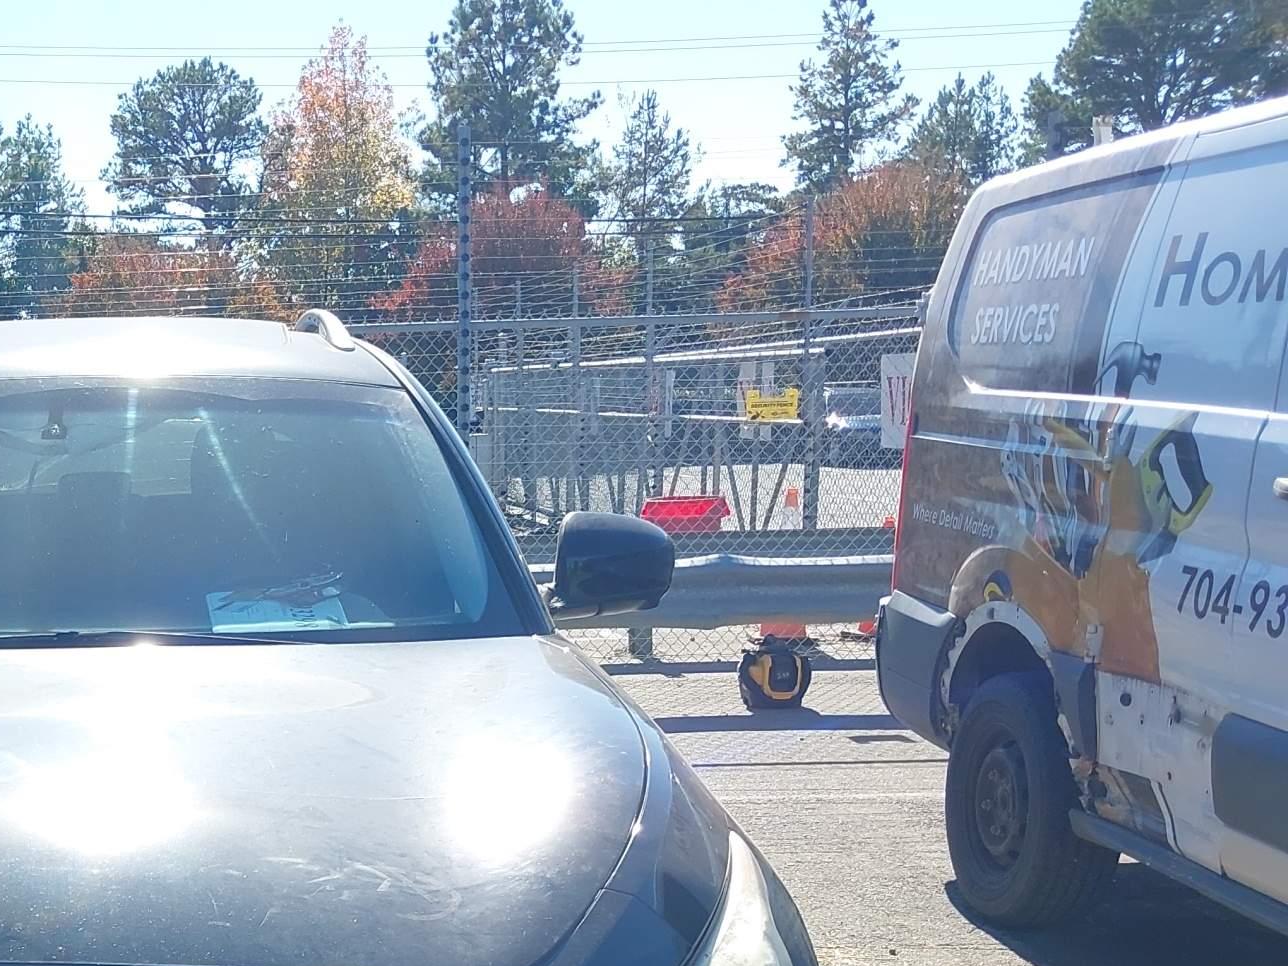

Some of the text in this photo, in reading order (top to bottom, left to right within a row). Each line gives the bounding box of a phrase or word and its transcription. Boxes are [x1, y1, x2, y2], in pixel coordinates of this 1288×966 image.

[973, 236, 1095, 286] HANDYMAN
[970, 302, 1060, 345] SERVICES
[913, 503, 995, 540] Where Detail Matters
[1177, 565, 1288, 639] 704-93
